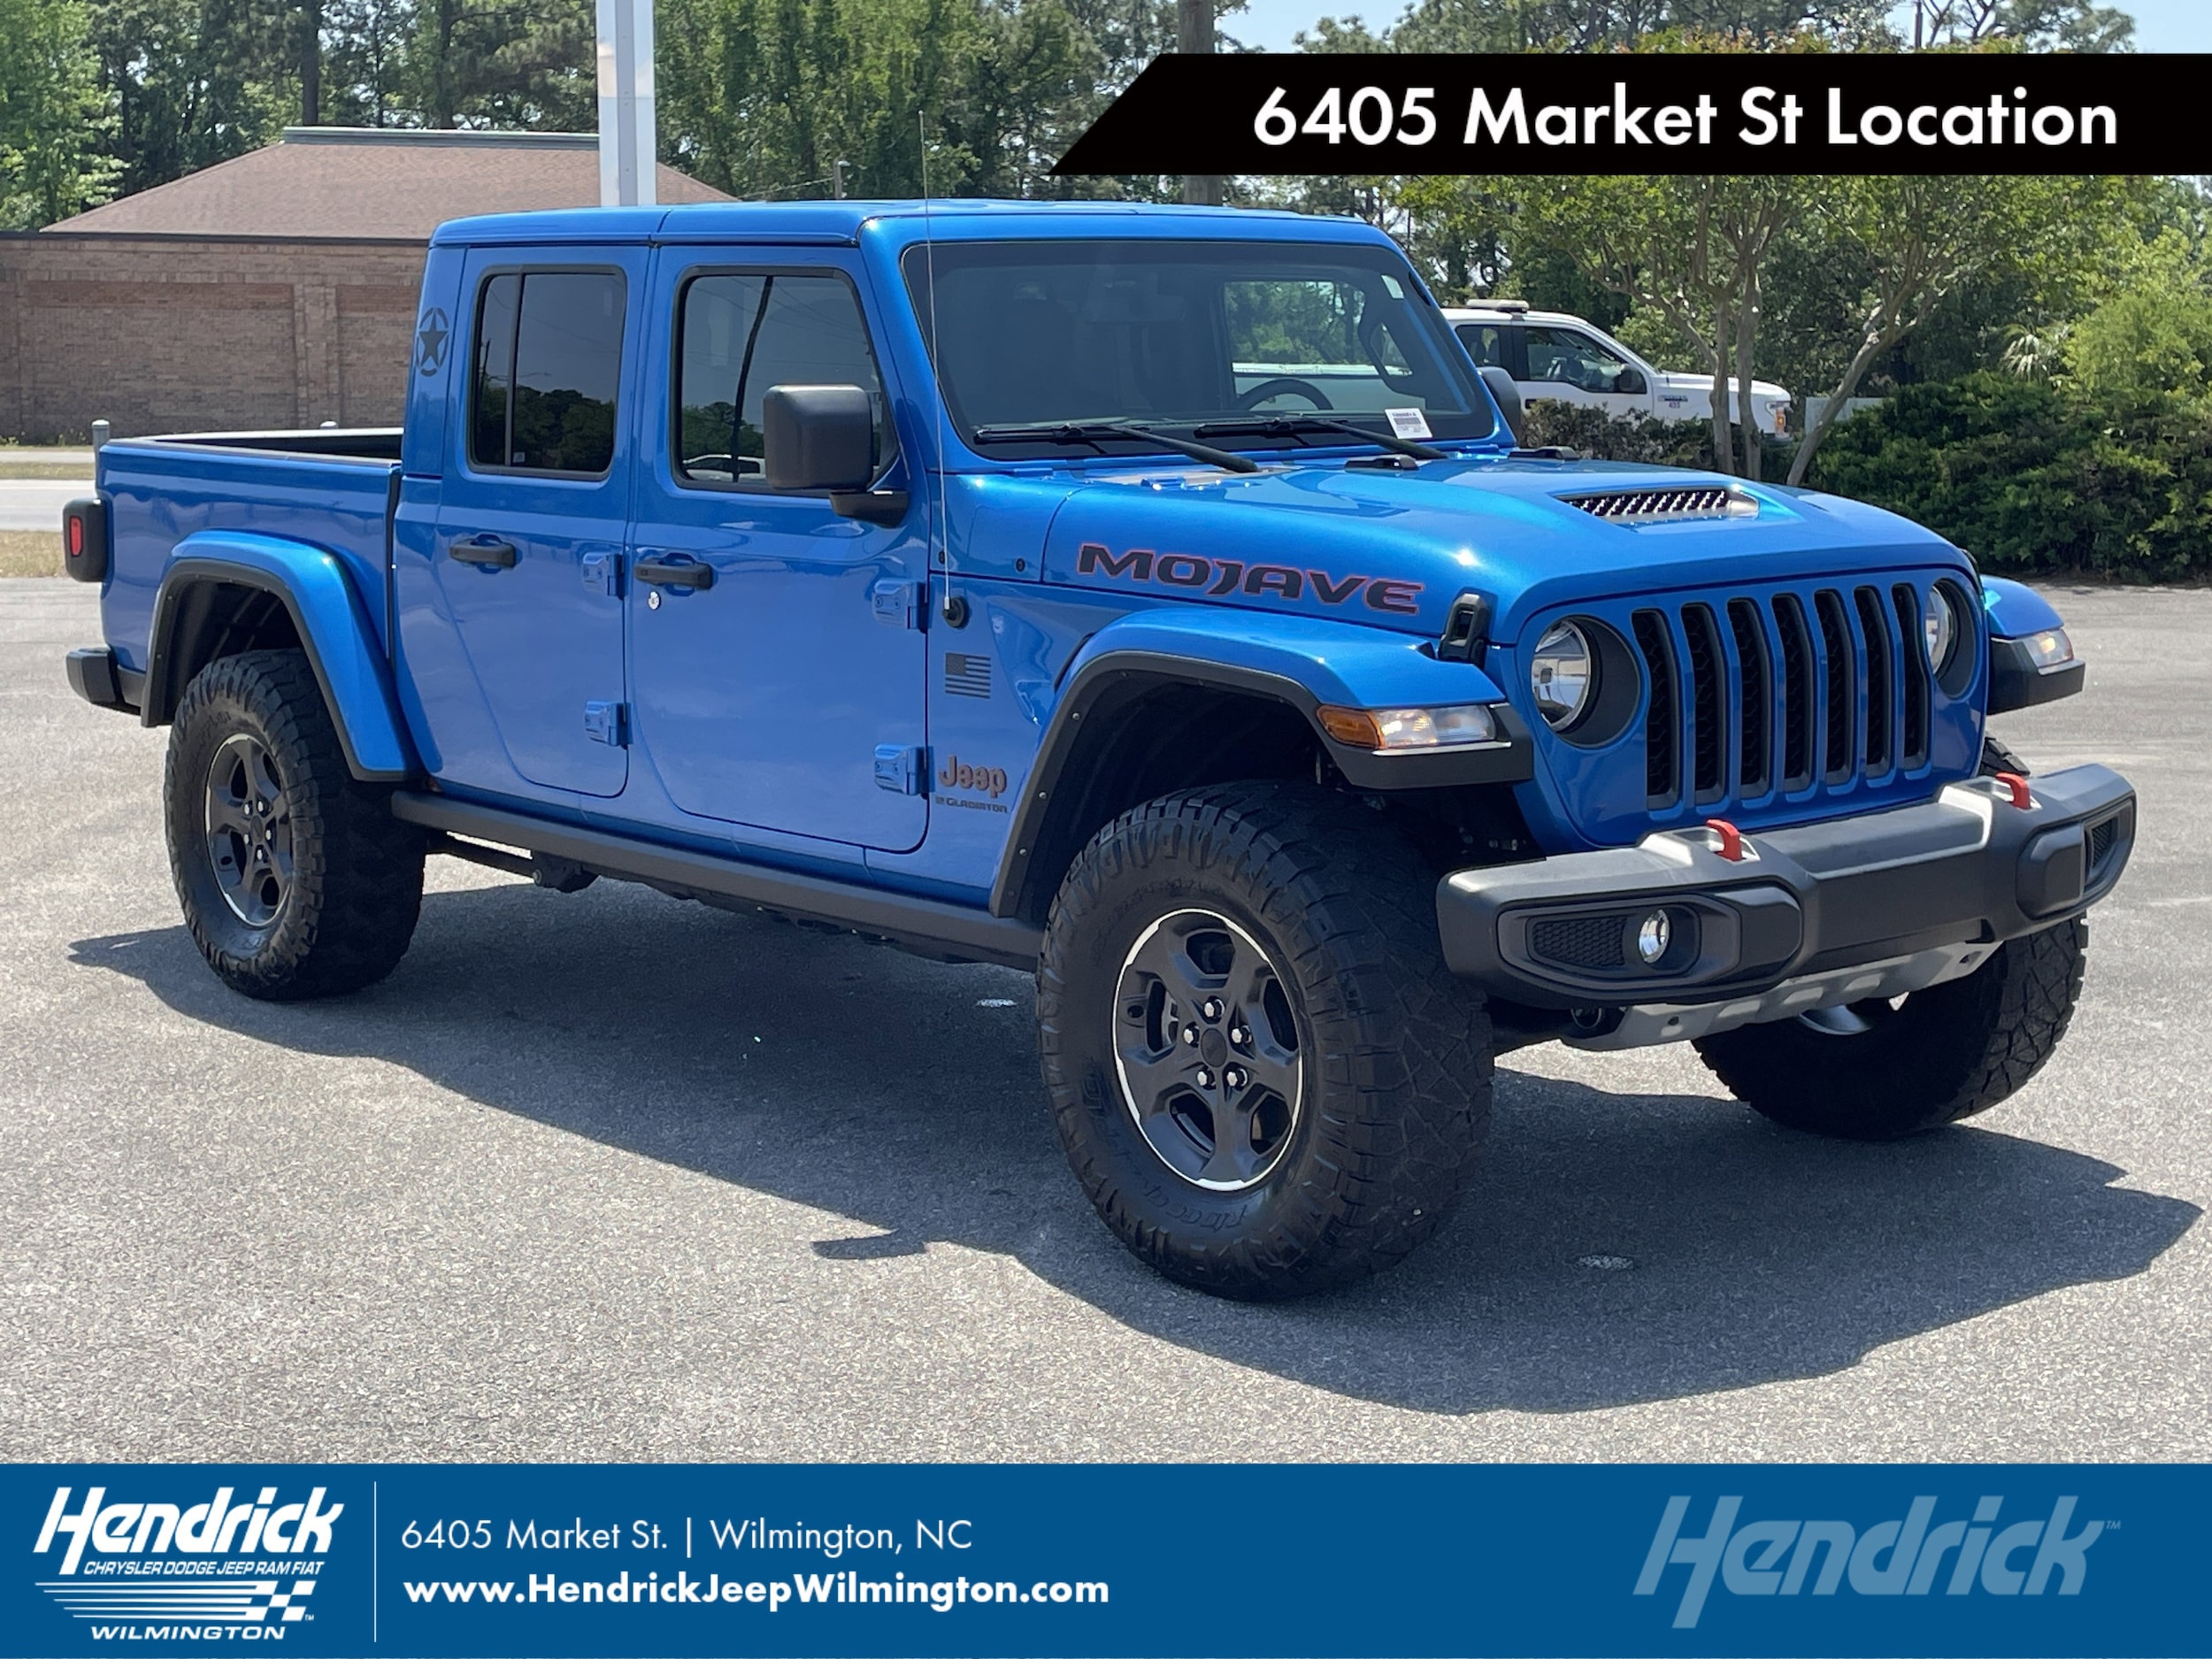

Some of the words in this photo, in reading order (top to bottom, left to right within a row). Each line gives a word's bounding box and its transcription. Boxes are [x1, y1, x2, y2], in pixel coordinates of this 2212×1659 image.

[1077, 543, 1424, 614] MOJAVE
[939, 755, 1007, 798] Jeep
[946, 797, 1008, 813] GLADIATOR
